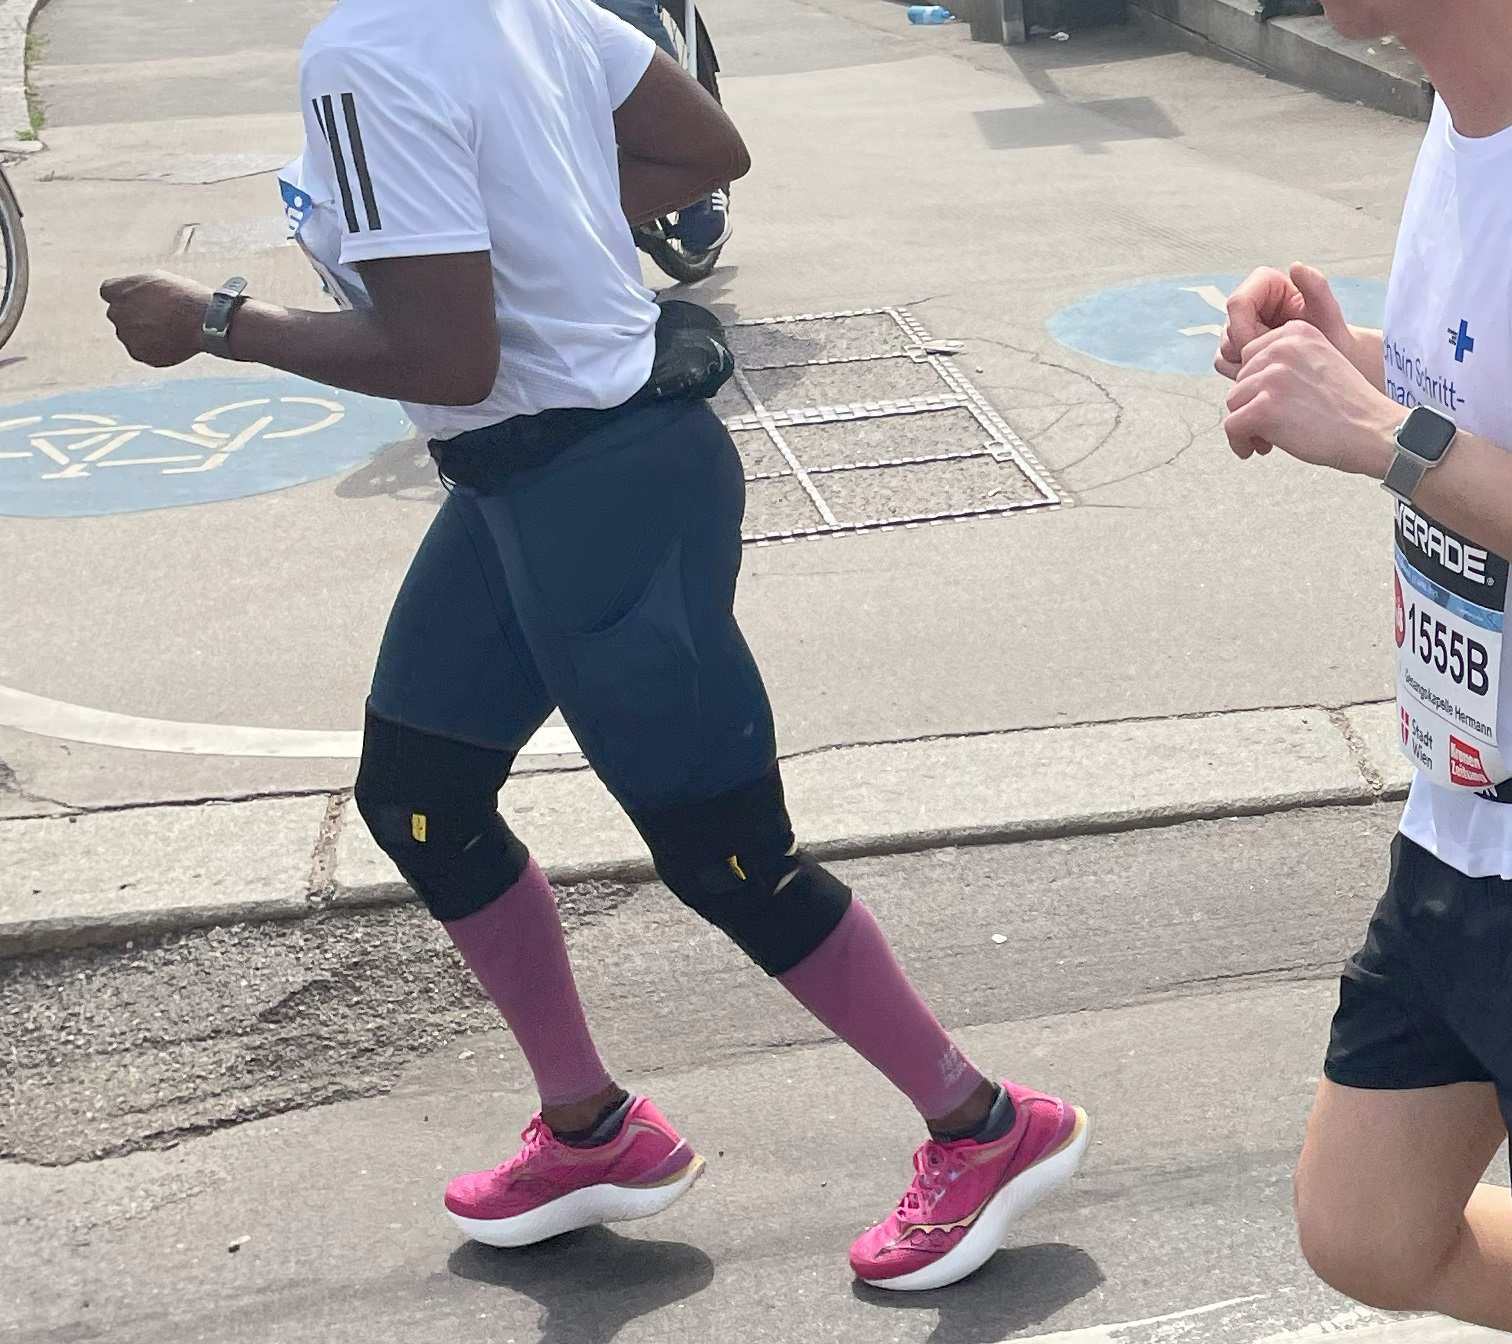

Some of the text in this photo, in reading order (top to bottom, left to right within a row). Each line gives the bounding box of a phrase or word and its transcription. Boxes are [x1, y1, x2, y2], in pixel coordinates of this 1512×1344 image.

[1394, 342, 1412, 381] bin
[1386, 377, 1421, 409] mac
[1409, 603, 1489, 696] 1555B
[1412, 718, 1433, 750] Stadt
[1455, 704, 1492, 738] Hermann
[1412, 738, 1433, 770] Wien
